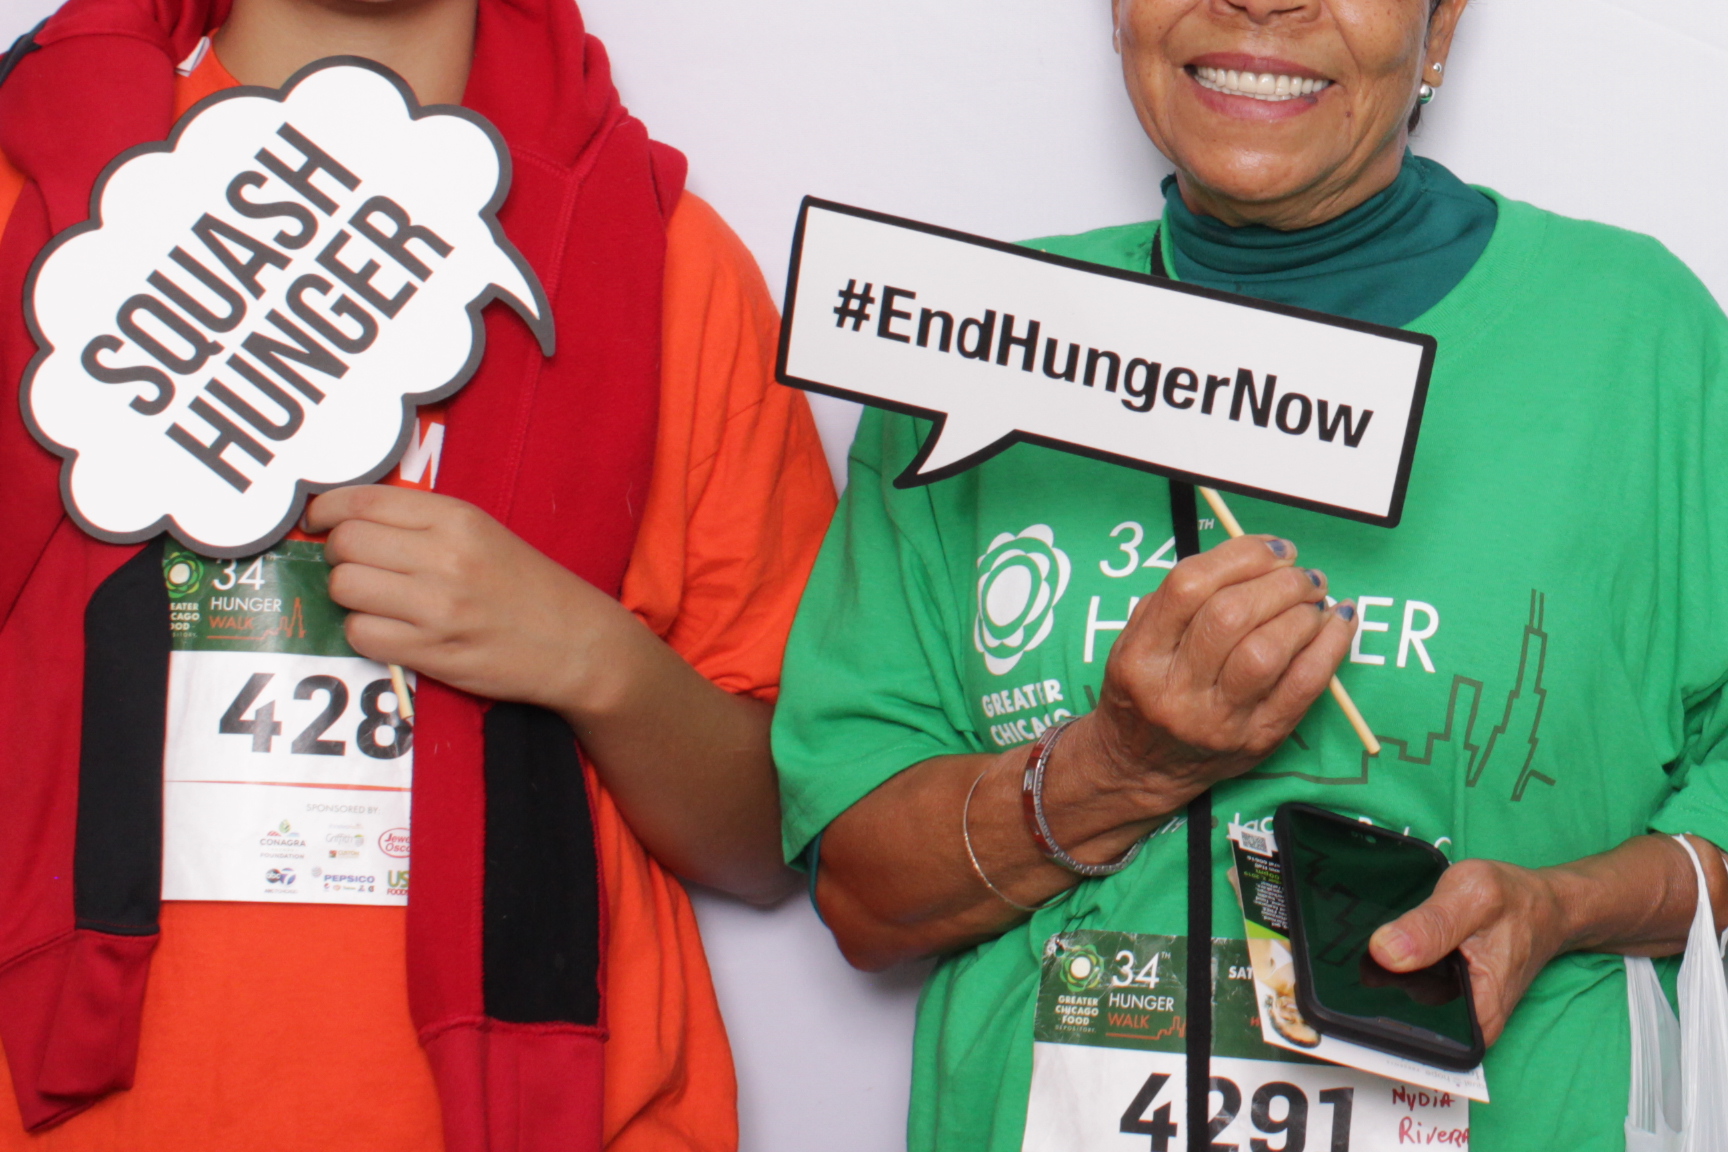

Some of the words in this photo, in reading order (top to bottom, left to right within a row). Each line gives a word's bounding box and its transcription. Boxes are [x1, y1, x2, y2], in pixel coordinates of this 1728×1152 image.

[81, 122, 362, 417] SQUASH
[165, 194, 455, 495] HUNGER
[833, 279, 1374, 449] #EndHungerNow
[170, 602, 199, 612] EATER
[210, 596, 282, 613] HUNGER
[170, 612, 201, 622] CAGO
[208, 615, 256, 631] WALK
[982, 679, 1064, 719] GREATER
[306, 803, 366, 814] SPONSORED
[260, 838, 306, 847] CONAGRA
[324, 874, 375, 884] PEPSICO
[1058, 995, 1099, 1006] GREATER
[1109, 993, 1175, 1012] HUNGER
[1055, 1005, 1099, 1016] CHICAGO
[1108, 1012, 1149, 1029] WALK
[1119, 1072, 1354, 1152] 4291
